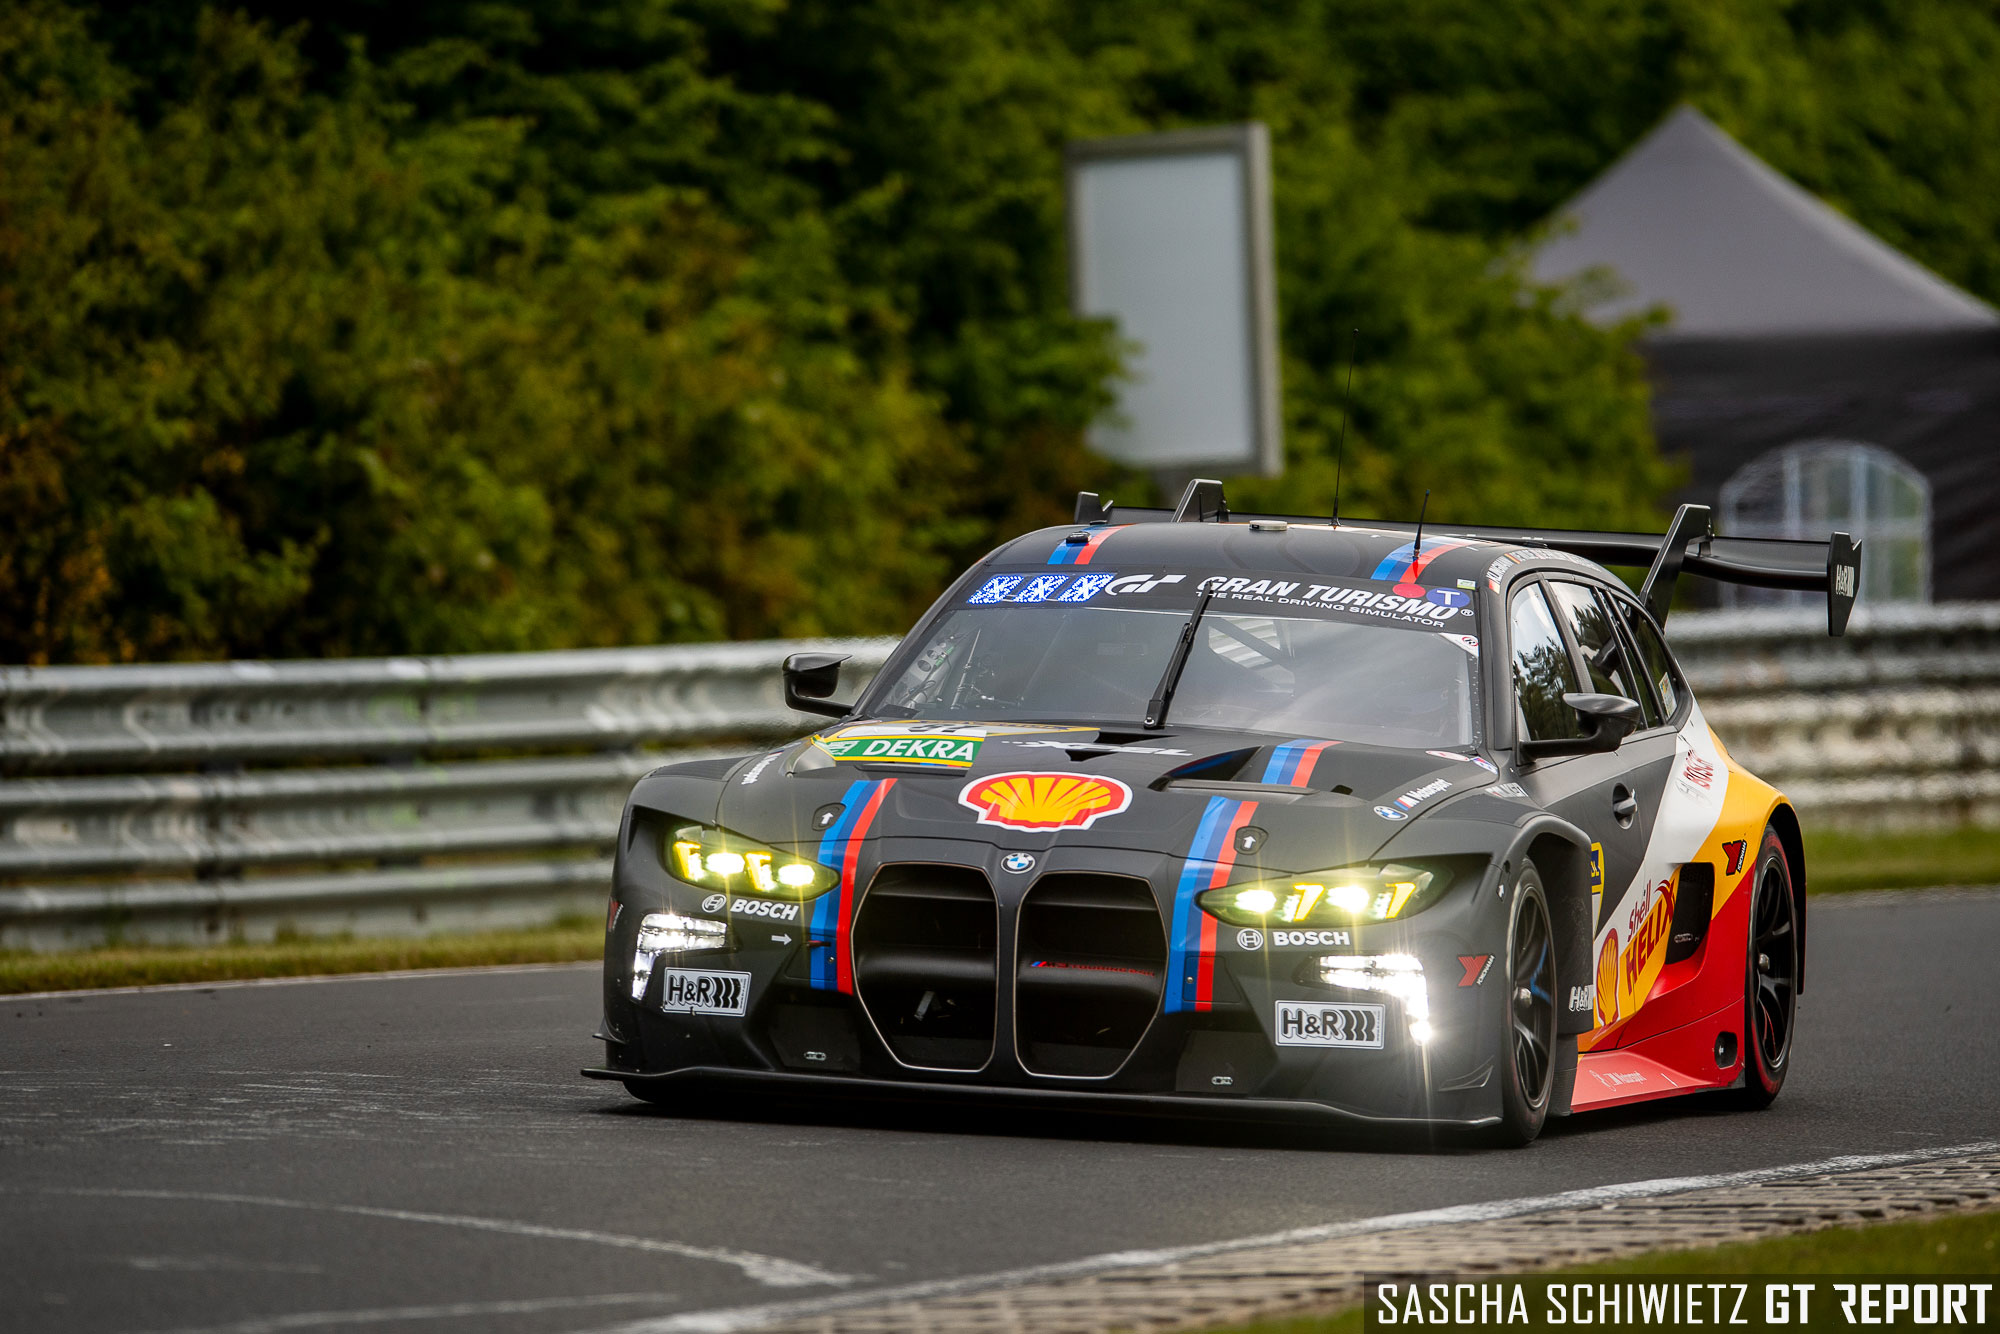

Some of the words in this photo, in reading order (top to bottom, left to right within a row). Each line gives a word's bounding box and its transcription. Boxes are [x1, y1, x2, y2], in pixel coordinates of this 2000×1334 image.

[1197, 576, 1301, 597] GRAN
[1302, 584, 1459, 620] TURISMO
[1231, 593, 1274, 603] REAL
[1277, 597, 1345, 611] DRIVING
[1349, 603, 1445, 628] SIMULATOR
[1436, 590, 1460, 605] T
[863, 740, 974, 762] DEKRA
[1406, 778, 1453, 801] Motorsport
[730, 898, 800, 921] BOSCH
[1627, 879, 1652, 943] Shell
[1273, 931, 1351, 946] BOSCH
[1625, 880, 1677, 996] HELIX
[669, 975, 711, 1003] H&R
[1282, 1009, 1341, 1038] H&R
